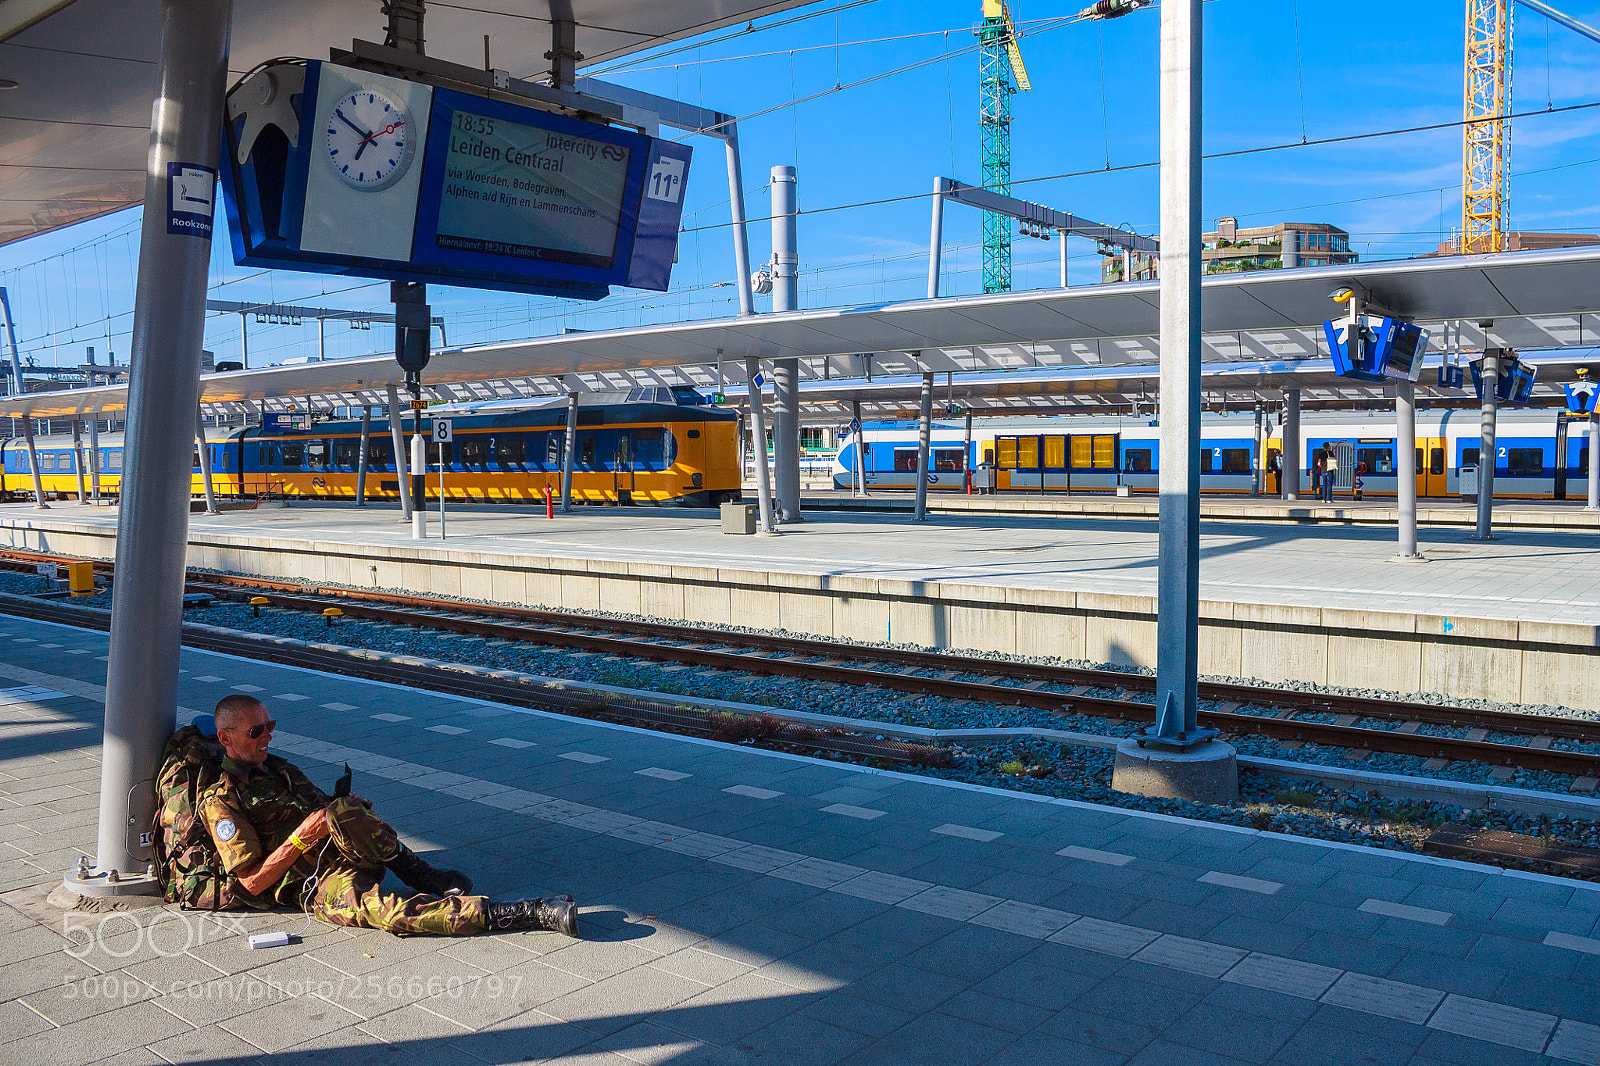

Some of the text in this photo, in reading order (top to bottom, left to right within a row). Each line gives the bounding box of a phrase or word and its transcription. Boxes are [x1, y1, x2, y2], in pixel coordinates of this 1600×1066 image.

[457, 113, 495, 135] 18:55
[451, 135, 564, 173] Leiden Centraal
[545, 132, 599, 160] Intercity
[448, 167, 567, 199] via Woerden, Bodegraven,
[445, 184, 596, 219] Alphen a/d Rijn en Lammenschans
[513, 245, 535, 257] Leiden
[412, 401, 427, 409] 2674
[437, 421, 448, 440] 8
[489, 438, 496, 449] 2
[1213, 447, 1221, 457] 2
[1498, 446, 1507, 458] 2
